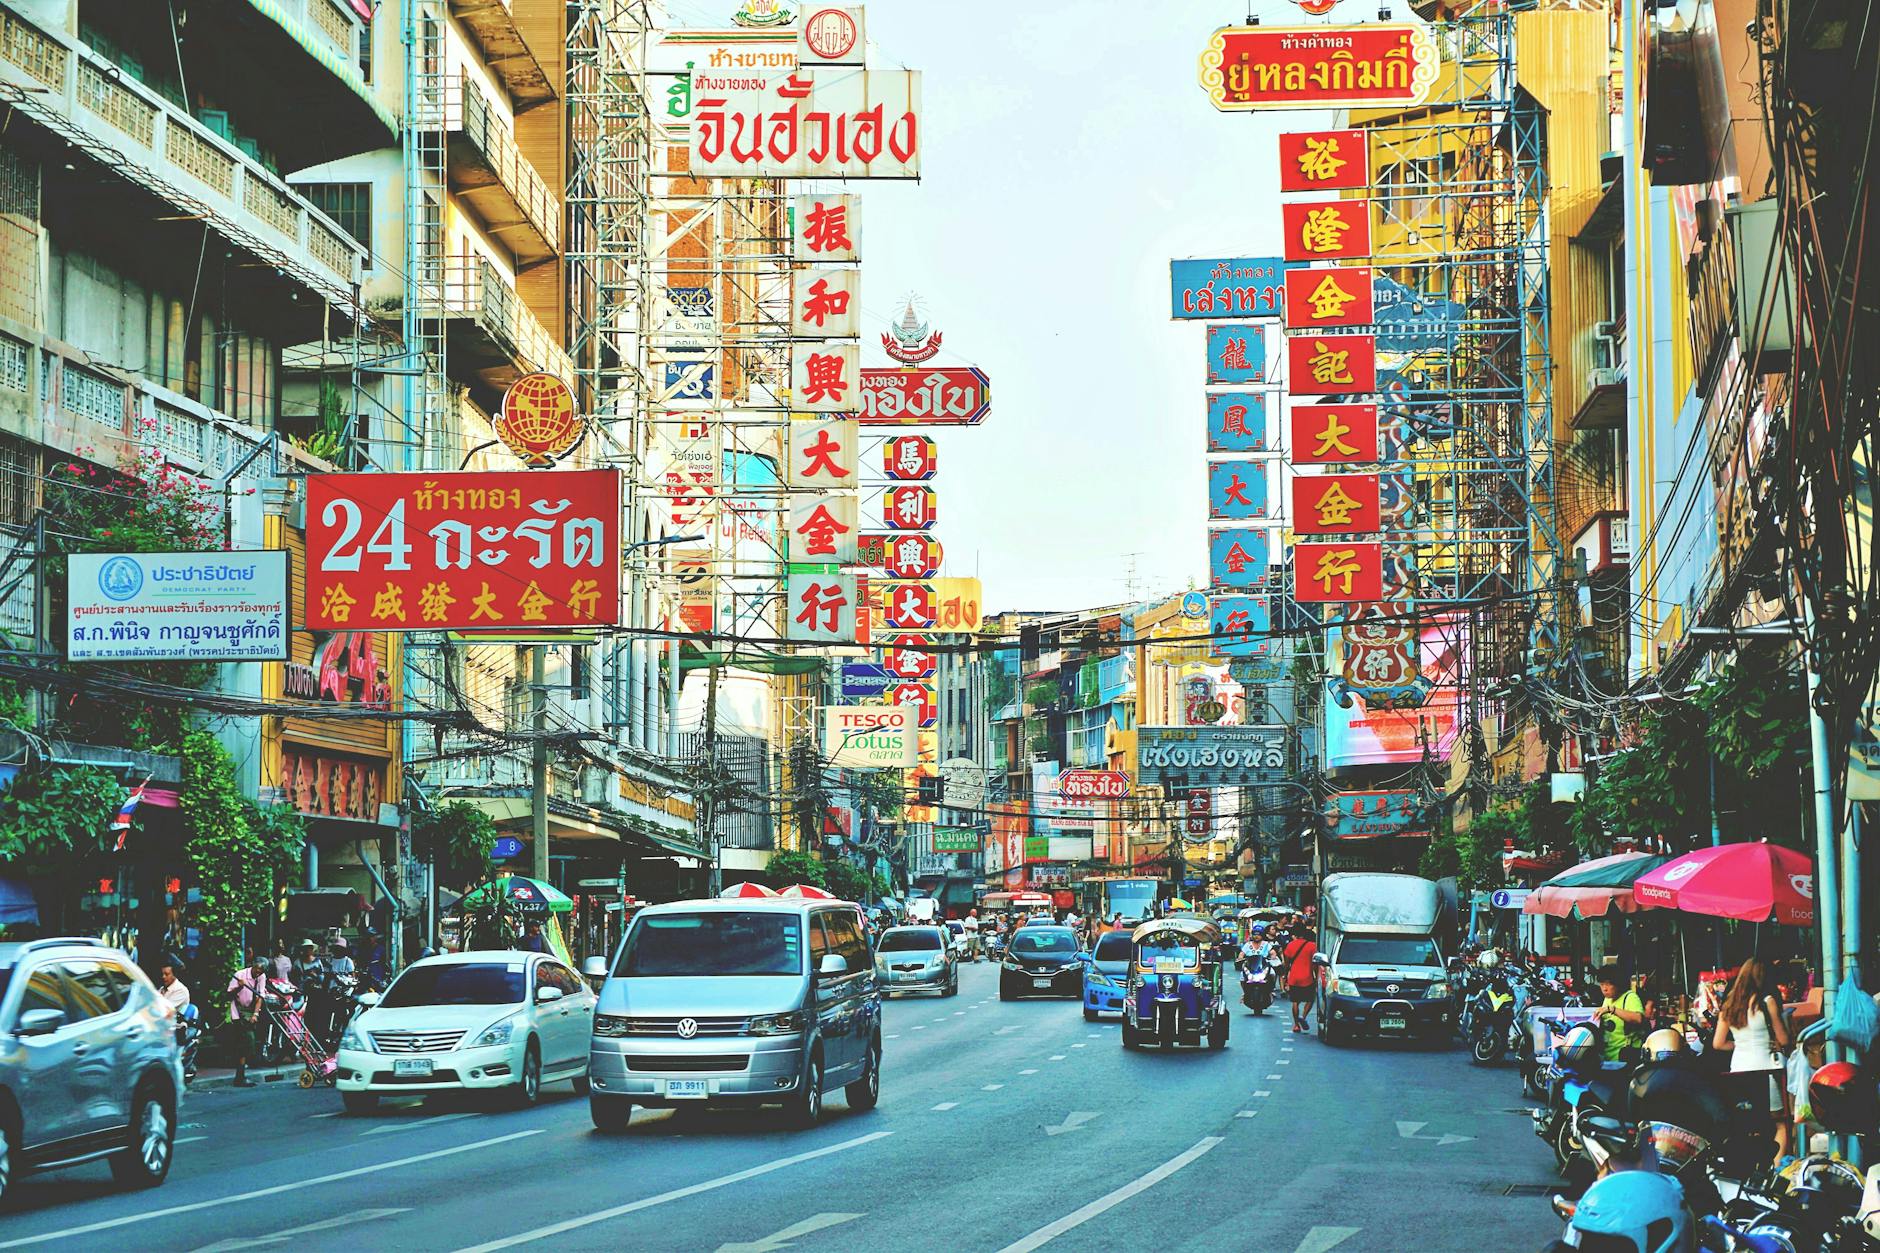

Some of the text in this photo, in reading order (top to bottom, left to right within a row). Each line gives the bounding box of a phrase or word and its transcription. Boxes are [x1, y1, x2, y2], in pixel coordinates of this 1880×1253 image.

[1281, 34, 1353, 49] ห้างค้าทอง
[1228, 35, 1408, 100] ยู่หลงกิมกี่
[695, 75, 766, 91] ห้างขายทอง
[413, 480, 521, 511] ห้างทอง
[320, 497, 605, 572] 24 กะรัต
[152, 564, 257, 582] ประชาธิปัตย์
[73, 621, 150, 641] ส.ก.พินิจ
[839, 714, 904, 726] TESCO
[843, 732, 903, 749] Lotus
[1642, 886, 1671, 900] foodpanda
